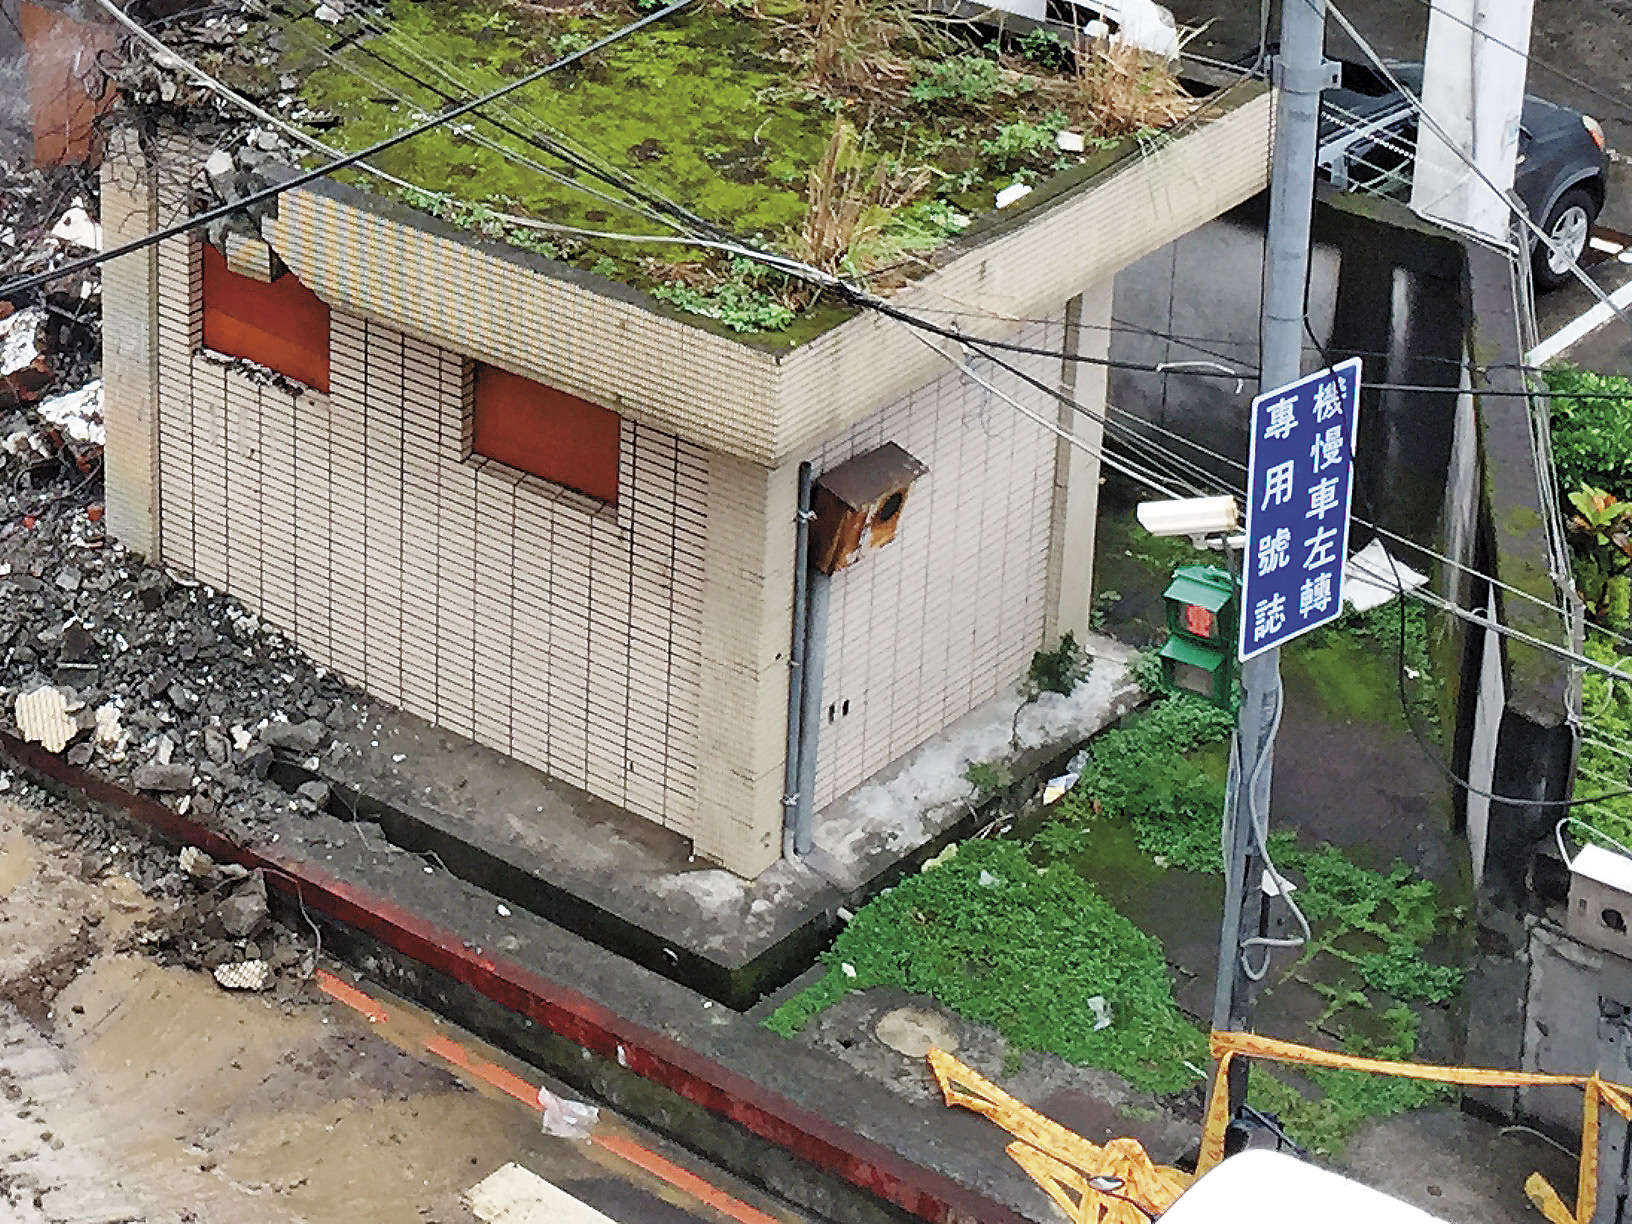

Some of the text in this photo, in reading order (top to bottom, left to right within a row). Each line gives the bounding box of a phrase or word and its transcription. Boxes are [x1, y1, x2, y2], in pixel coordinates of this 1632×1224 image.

[1253, 394, 1299, 642] 專用號誌
[1298, 376, 1347, 619] 機慢車左轉
